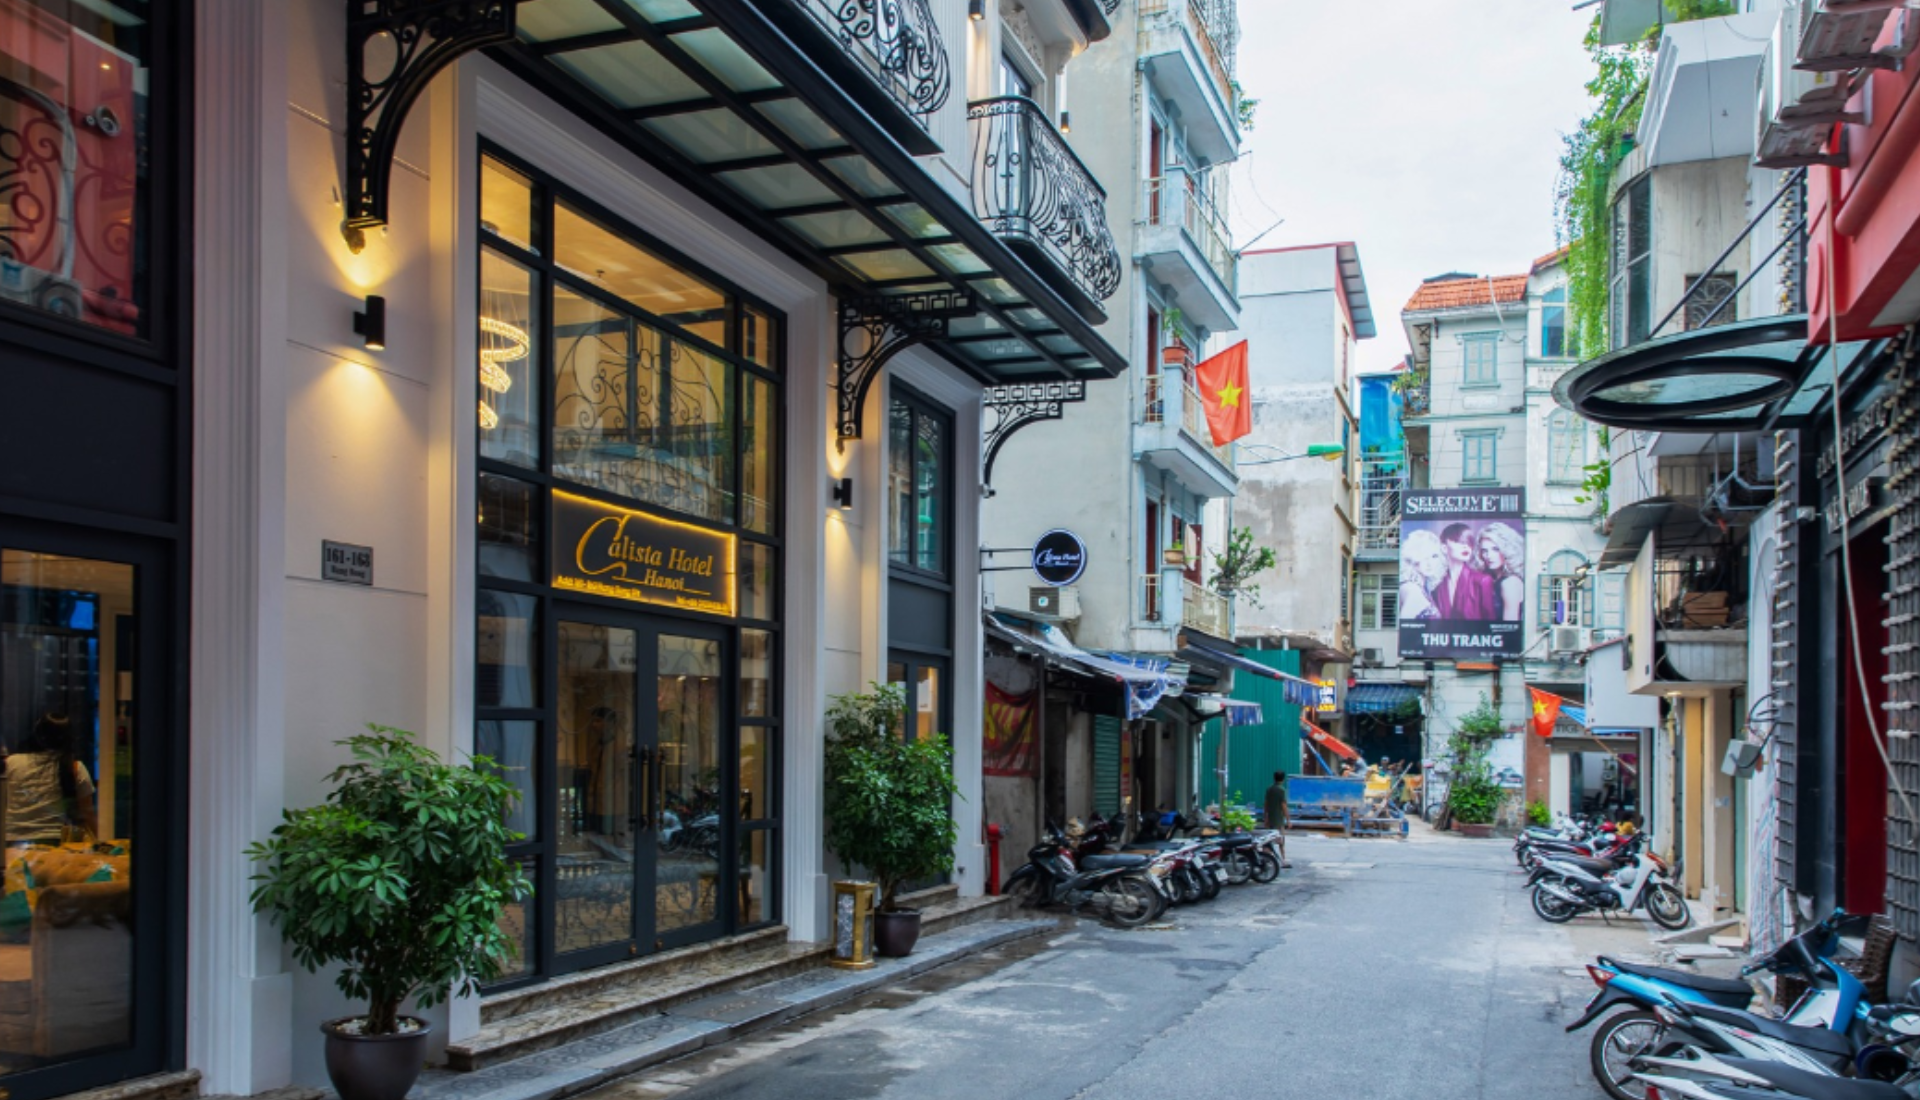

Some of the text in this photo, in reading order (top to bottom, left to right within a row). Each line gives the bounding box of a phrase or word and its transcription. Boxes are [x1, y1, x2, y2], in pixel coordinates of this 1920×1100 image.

[575, 514, 713, 577] Calista Hotel
[644, 569, 685, 592] Hanoi
[1421, 633, 1503, 647] THU TRANG
